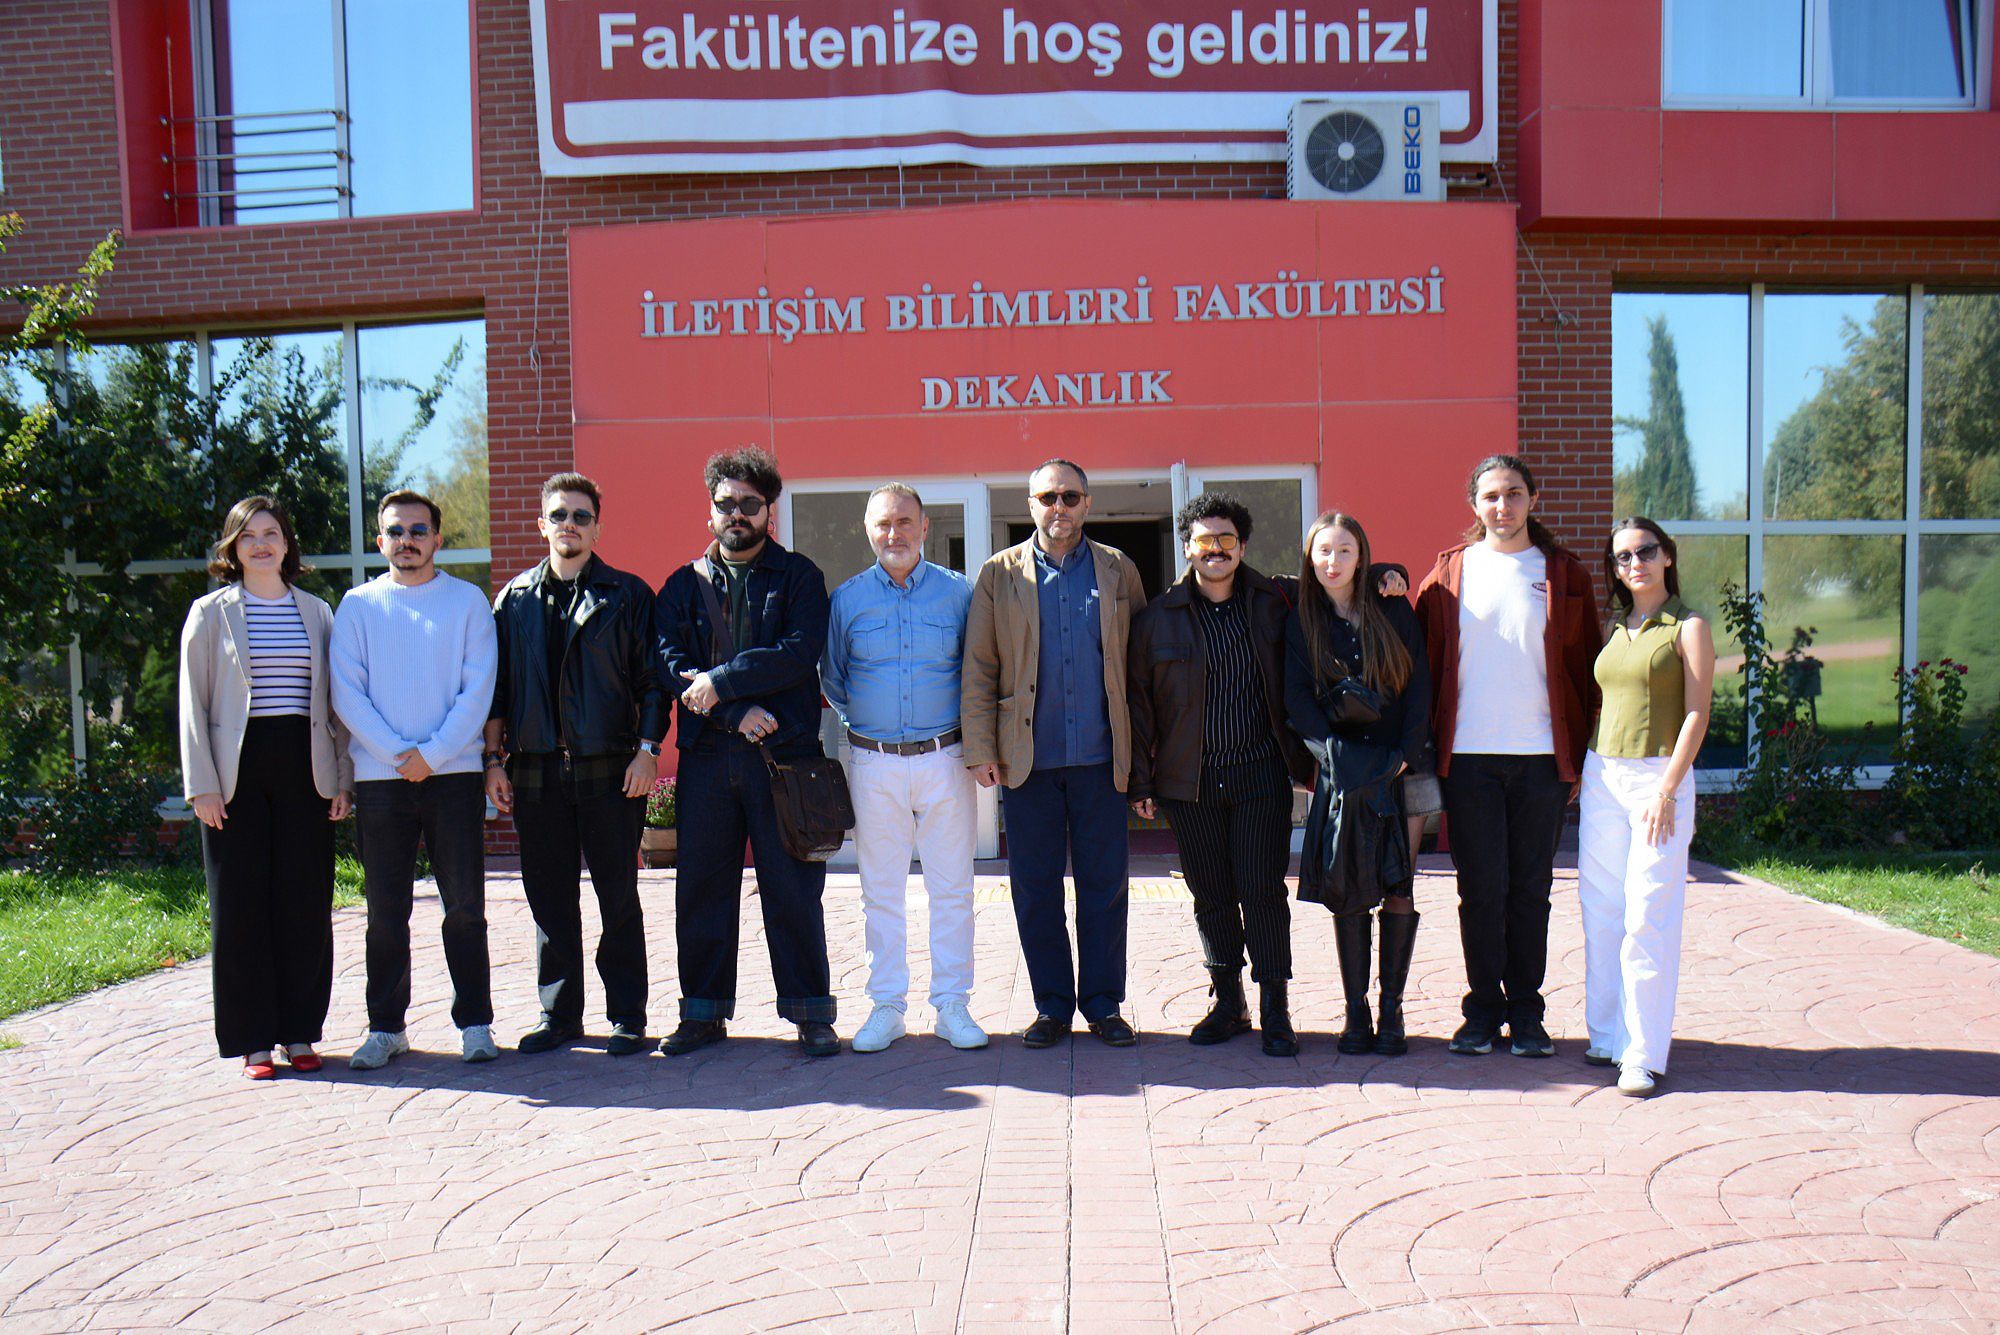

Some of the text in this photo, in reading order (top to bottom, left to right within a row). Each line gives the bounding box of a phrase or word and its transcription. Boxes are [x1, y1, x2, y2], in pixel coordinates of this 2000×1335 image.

[598, 7, 1428, 79] Fakültenize hoş geldiniz!
[1404, 106, 1421, 193] BEKO
[640, 266, 1446, 344] İLETİŞİM BİLİMLERİ FAKÜLTESİ
[920, 370, 1174, 411] DEKANLIK
